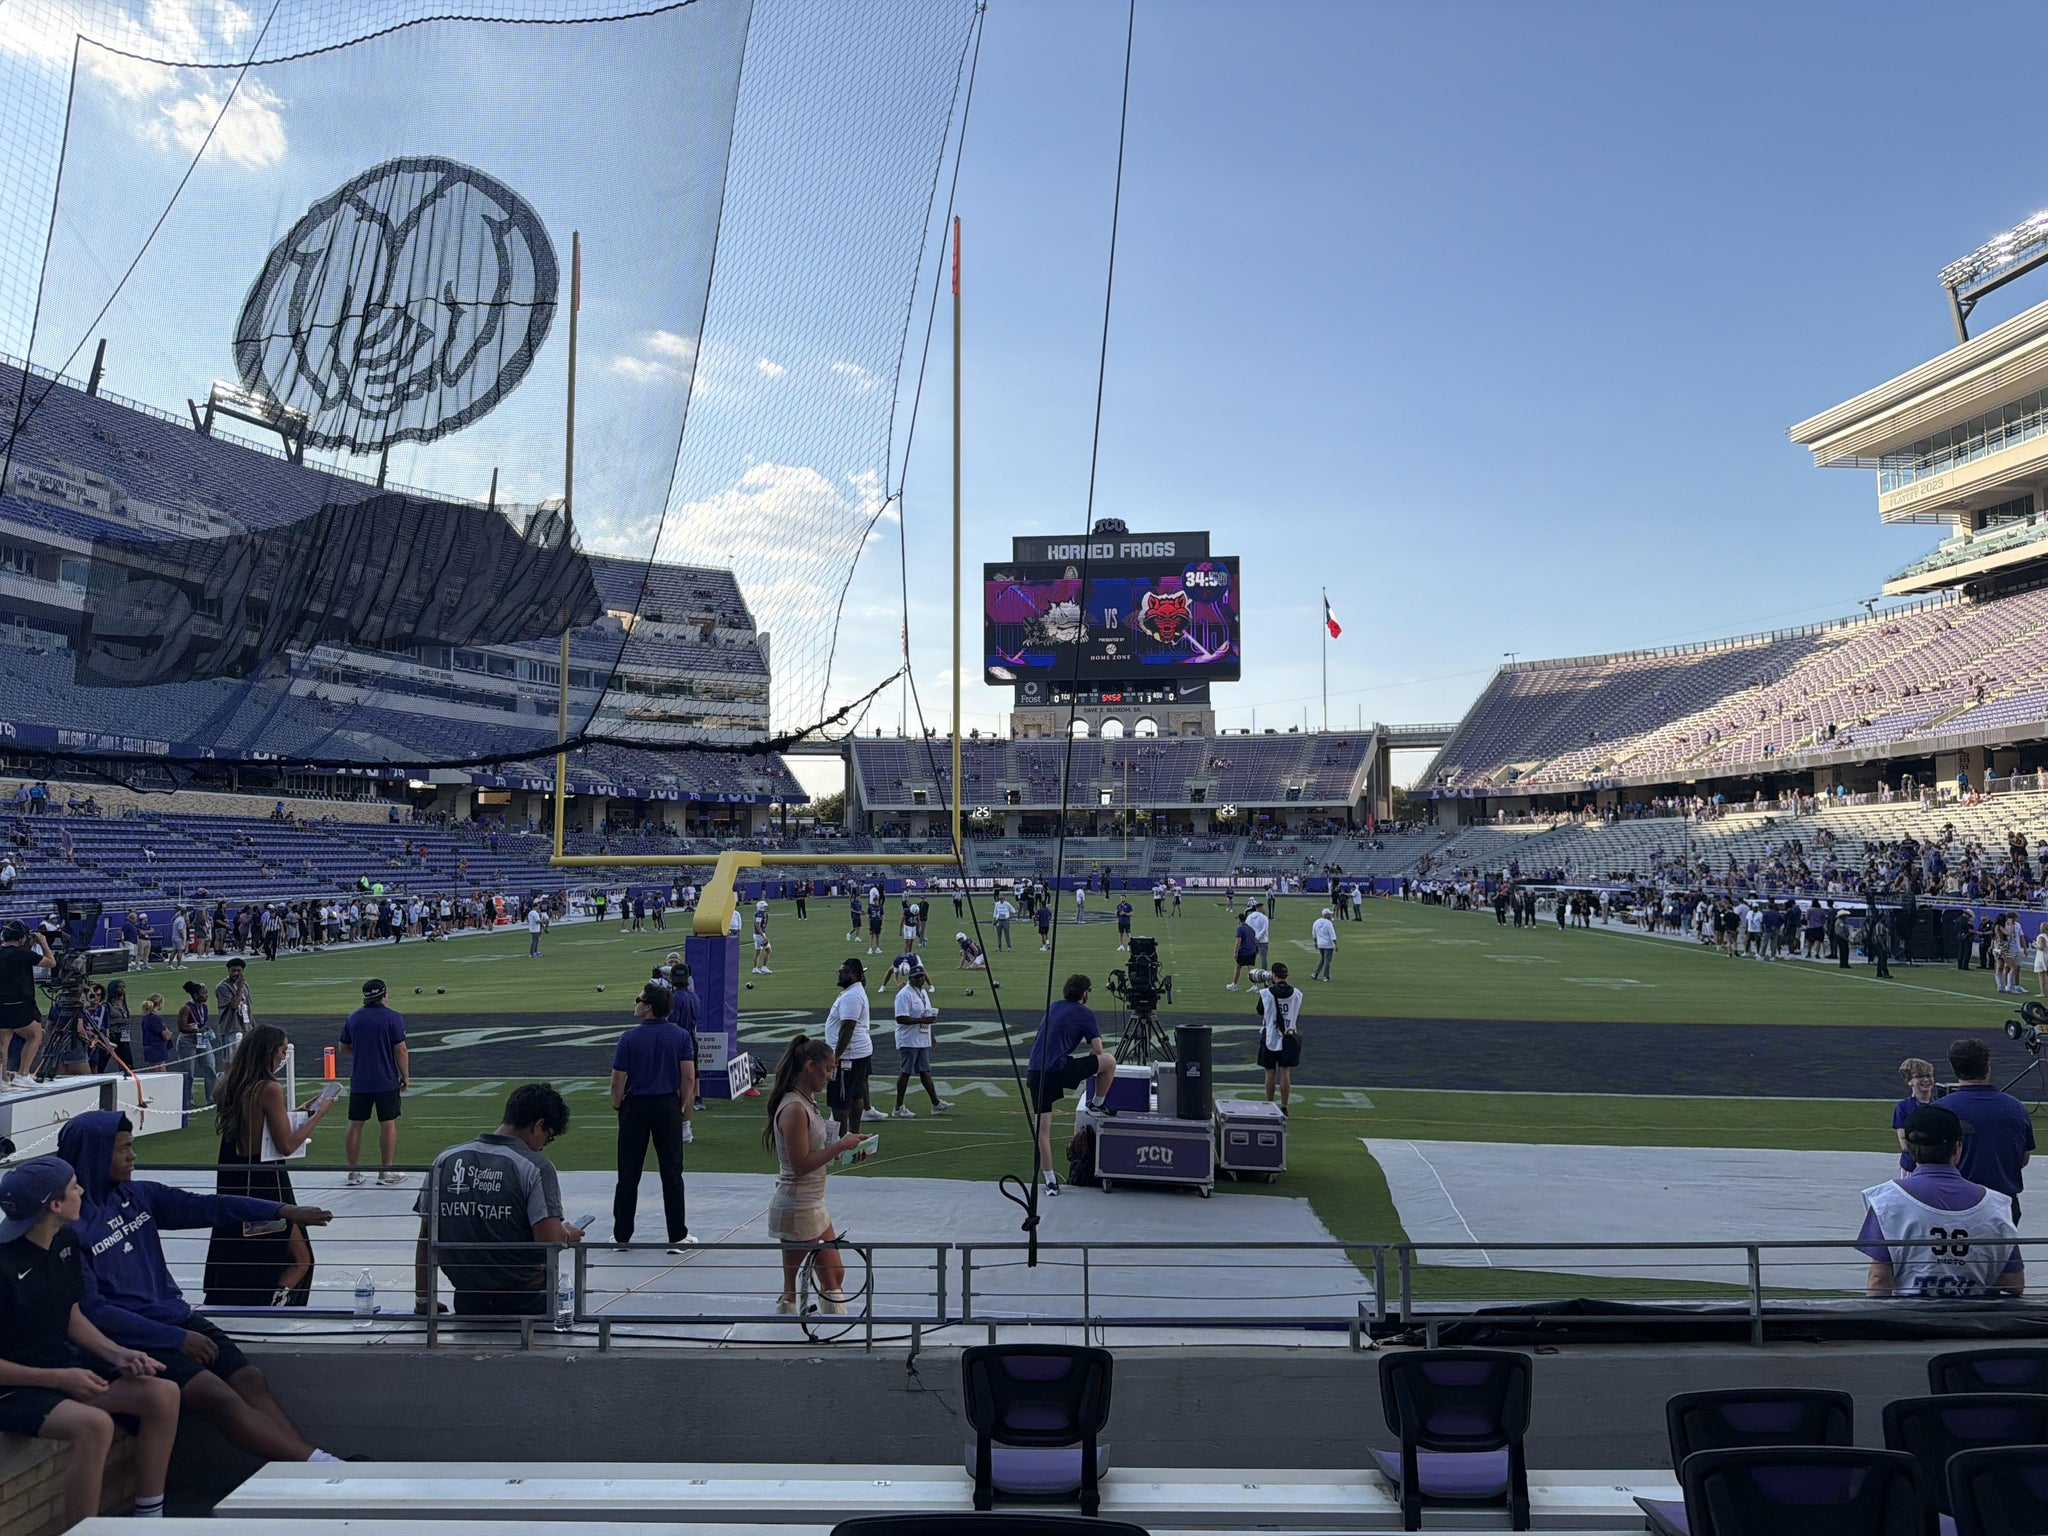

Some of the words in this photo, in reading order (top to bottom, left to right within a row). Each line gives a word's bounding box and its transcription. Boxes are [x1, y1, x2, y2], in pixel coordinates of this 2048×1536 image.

[66, 483, 87, 498] BOWL
[1890, 490, 1919, 506] PLAYOFF
[1920, 479, 1944, 495] 2023
[163, 512, 189, 526] LIBERTY
[1095, 518, 1126, 534] TCU
[1048, 543, 1114, 560] HORNED
[1120, 541, 1175, 558] FROGS
[1104, 607, 1118, 629] VS
[1020, 694, 1041, 703] Frost
[1060, 693, 1071, 701] TCU
[1152, 691, 1163, 699] ASU
[976, 806, 990, 817] 25
[1221, 804, 1235, 815] 25
[1136, 1145, 1173, 1163] TCU
[468, 1165, 503, 1180] Stadium
[472, 1178, 501, 1194] People
[441, 1201, 476, 1217] EVENT
[477, 1203, 512, 1220] STAFF
[107, 1215, 124, 1230] TCU
